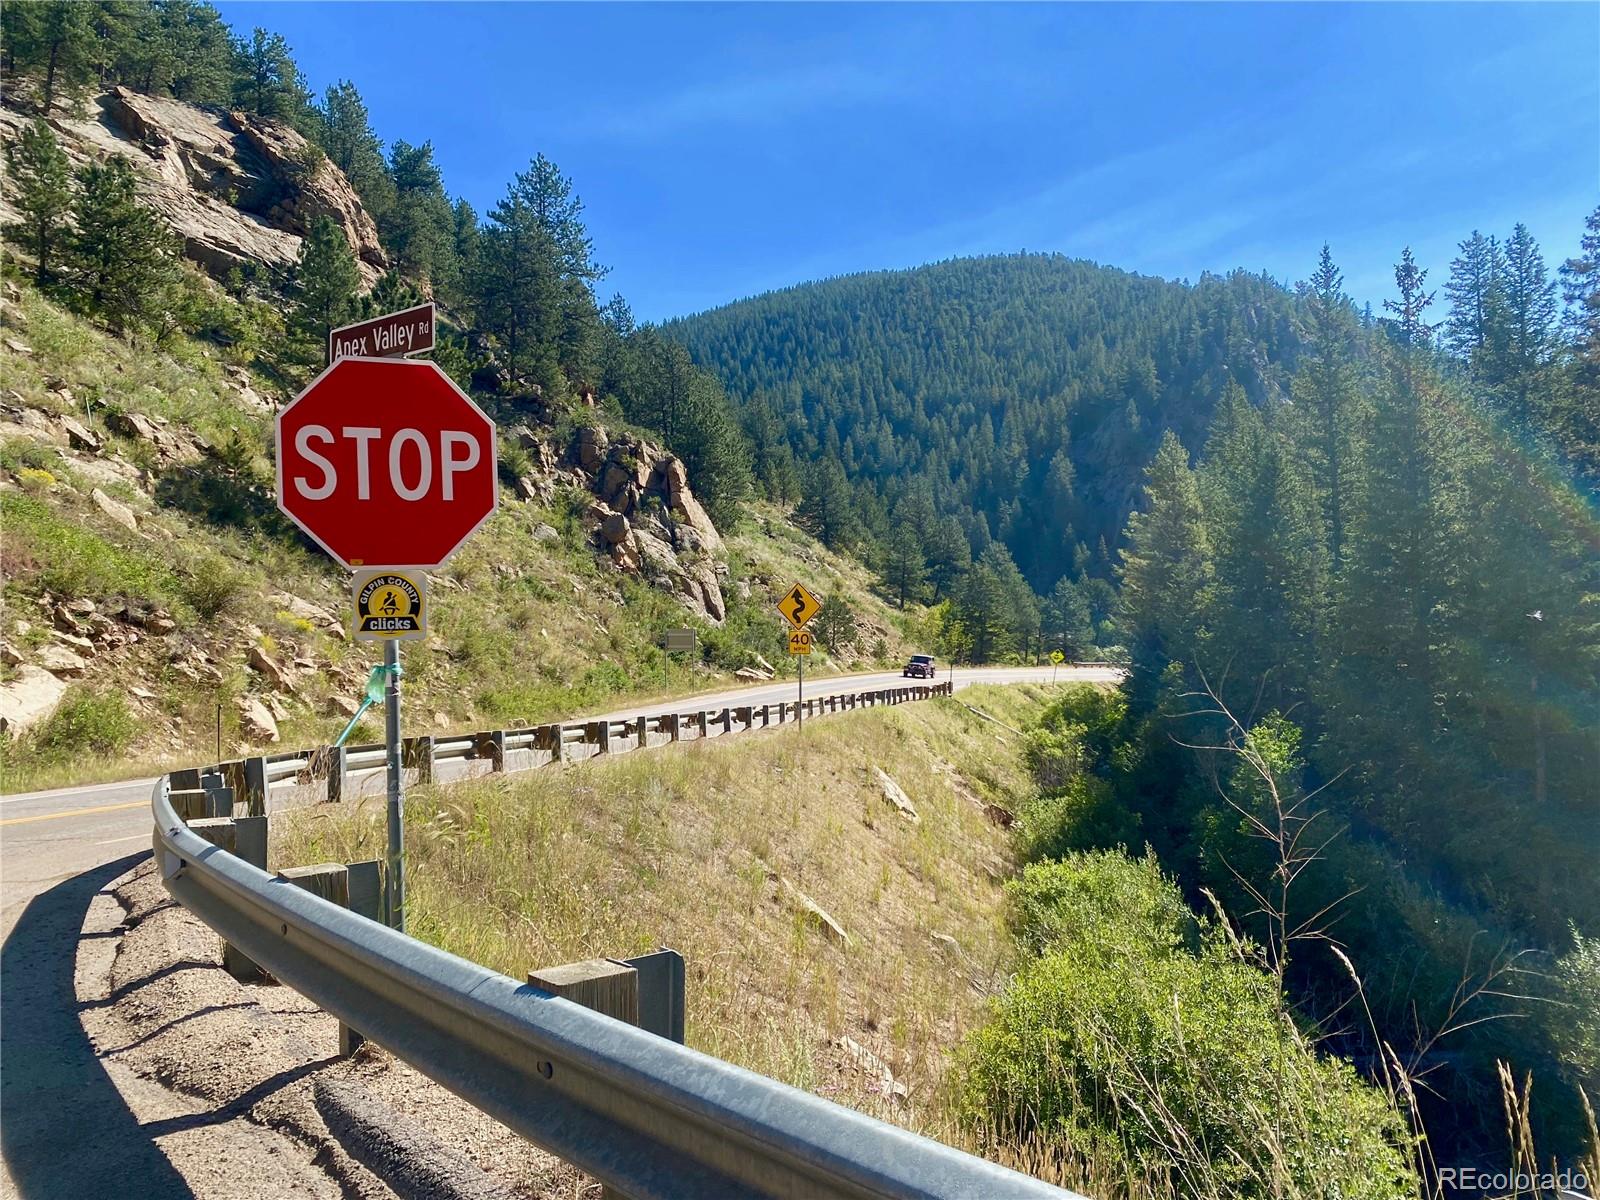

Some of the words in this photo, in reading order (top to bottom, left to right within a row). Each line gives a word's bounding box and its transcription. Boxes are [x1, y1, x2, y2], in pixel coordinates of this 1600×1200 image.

[373, 323, 414, 352] Valley
[418, 320, 429, 336] Rd
[293, 424, 481, 502] STOP
[360, 578, 385, 604] GILPIN
[387, 576, 419, 604] COUNTY
[369, 617, 411, 630] clicks
[790, 633, 809, 645] 40
